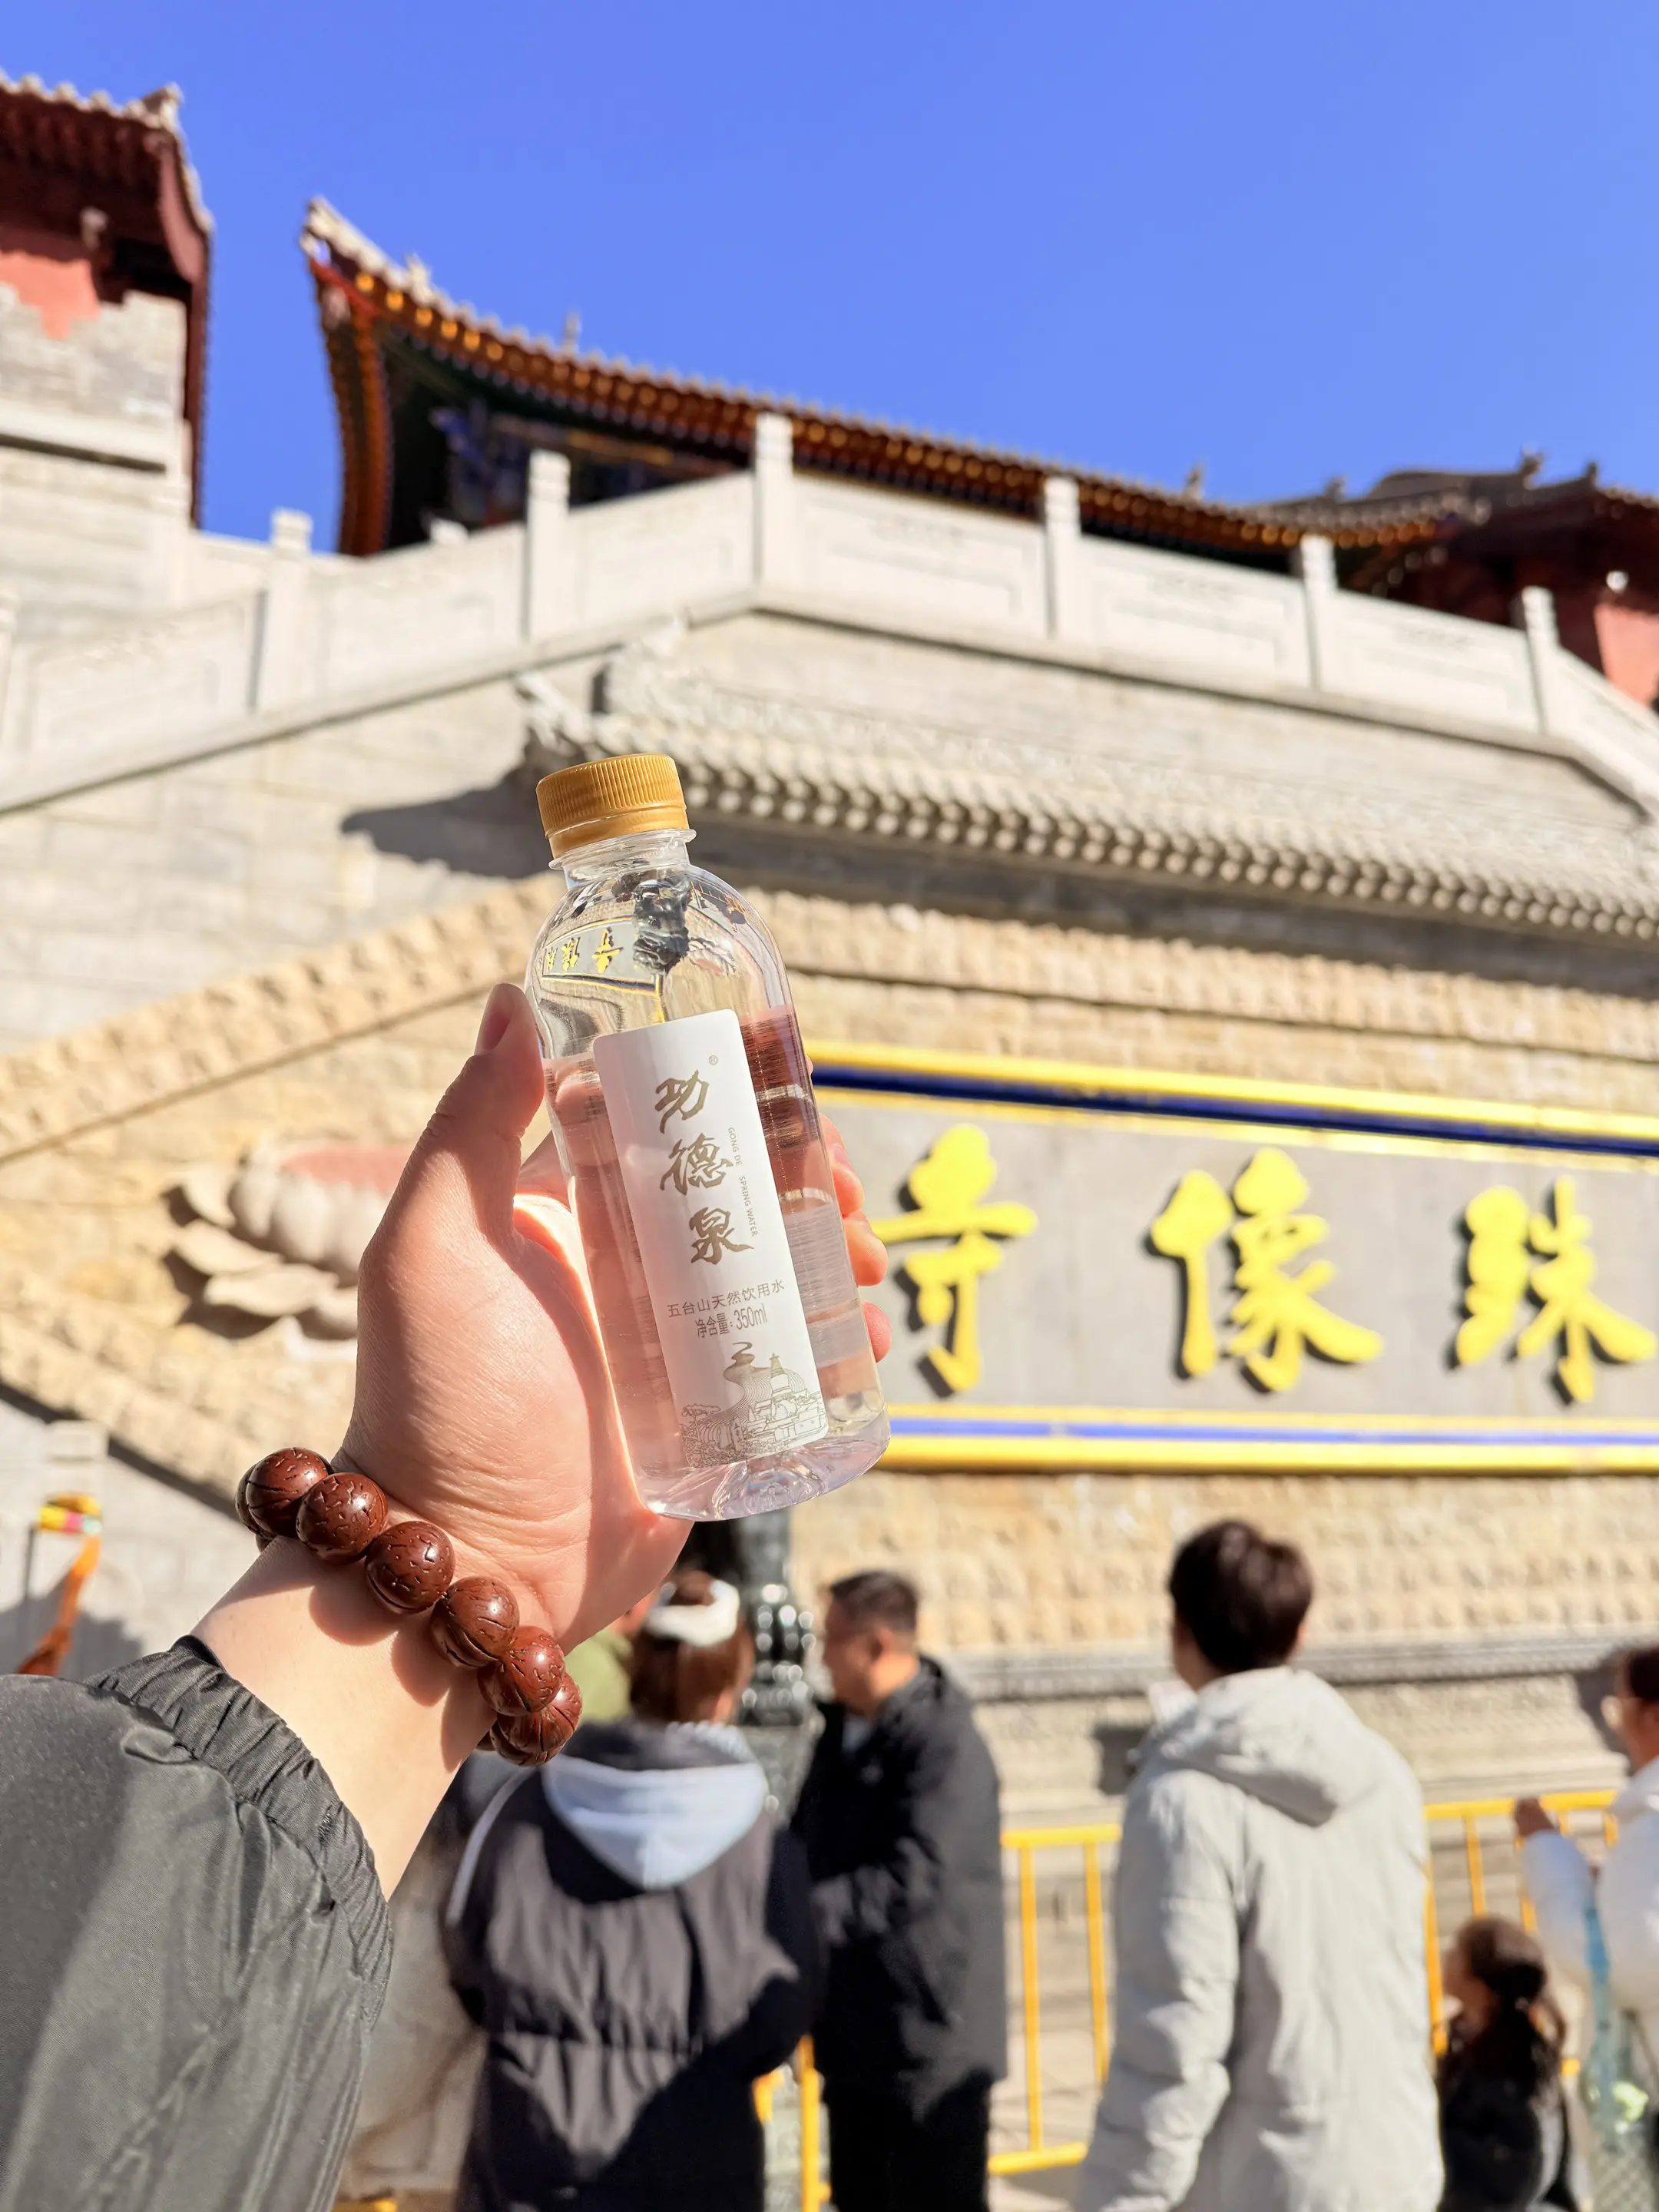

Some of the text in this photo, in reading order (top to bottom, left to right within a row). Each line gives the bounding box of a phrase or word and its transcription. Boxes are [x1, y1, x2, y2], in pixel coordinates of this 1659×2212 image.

[654, 1070, 754, 1265] 功德泉
[727, 1127, 758, 1237] GONG DE SPRING WATER
[667, 1279, 785, 1318] 五台山天然饮用水
